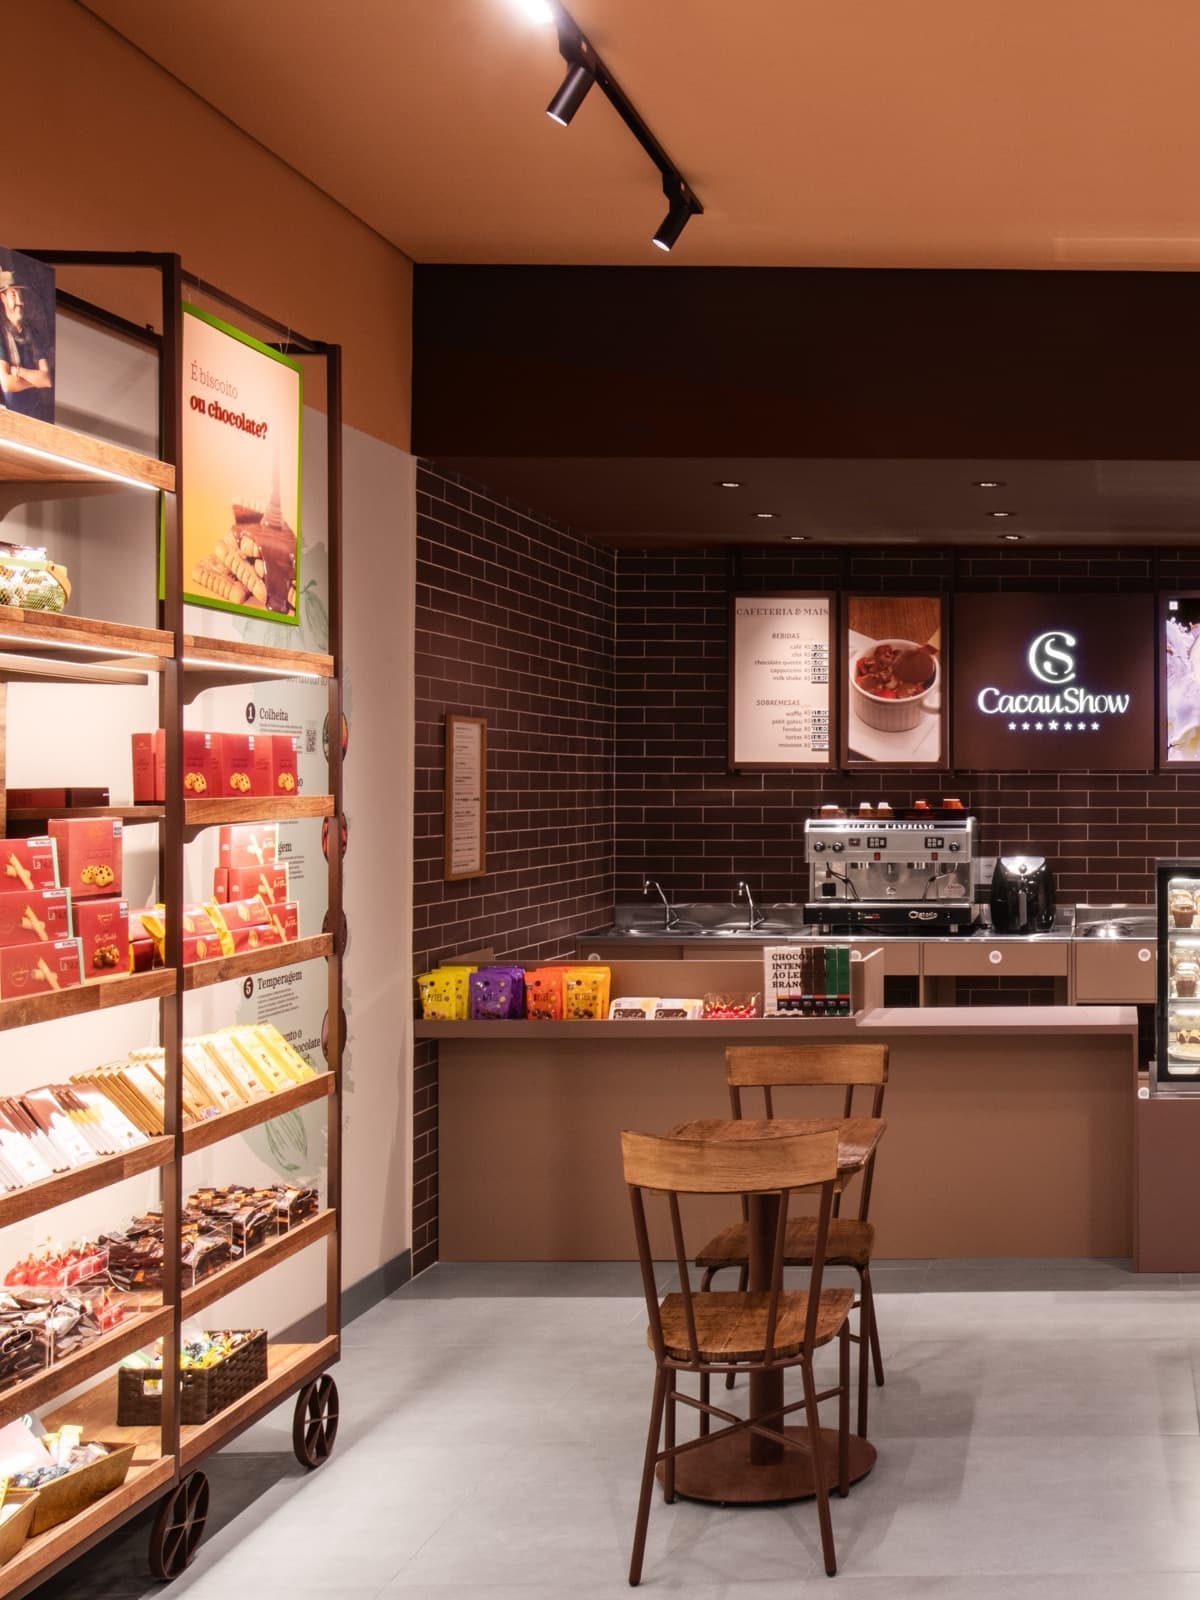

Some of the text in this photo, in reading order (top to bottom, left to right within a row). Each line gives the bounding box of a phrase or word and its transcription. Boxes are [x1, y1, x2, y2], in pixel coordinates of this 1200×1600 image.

[190, 360, 239, 400] É biscoito
[190, 393, 268, 440] ou chocolate?
[736, 608, 793, 616] CAFETERIA
[259, 707, 289, 721] Colheita
[257, 971, 302, 990] Temperagem
[293, 1038, 321, 1053] hocolate
